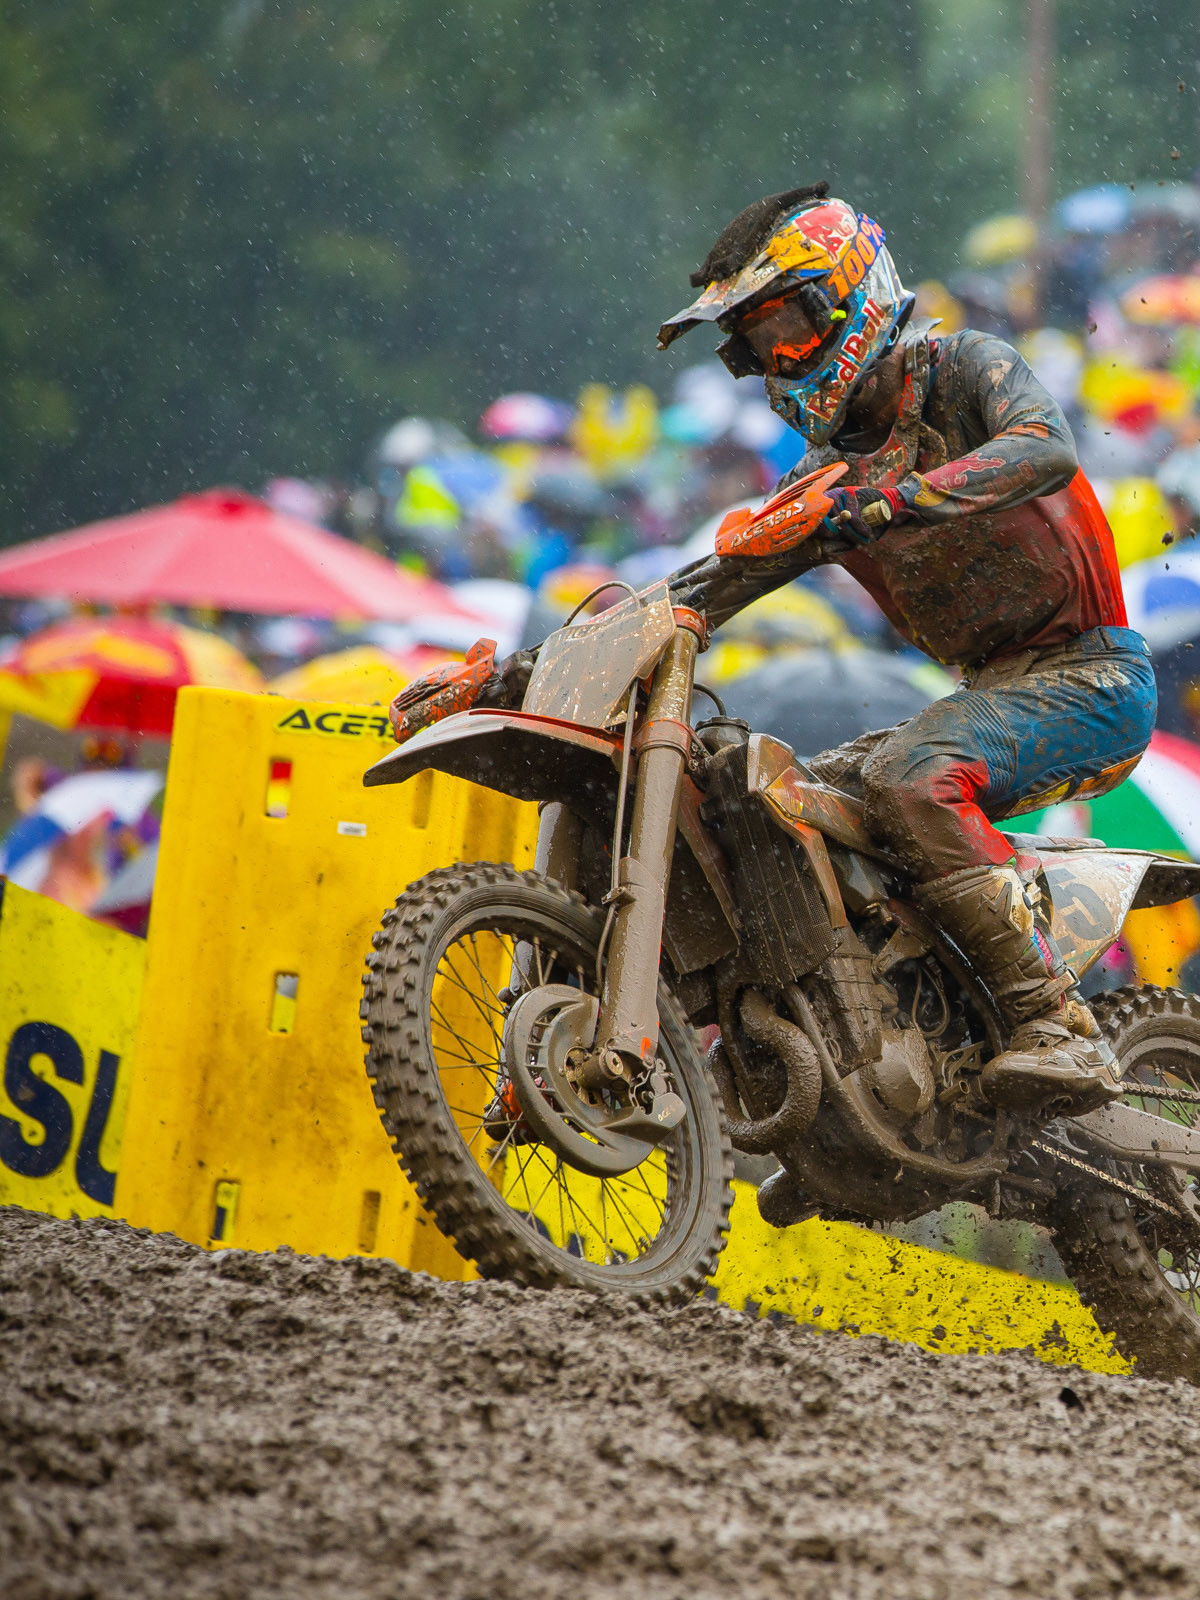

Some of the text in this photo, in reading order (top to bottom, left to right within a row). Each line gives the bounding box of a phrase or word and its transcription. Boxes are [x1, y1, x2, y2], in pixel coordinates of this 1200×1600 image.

[827, 213, 885, 300] 100%
[841, 298, 887, 365] Bull
[278, 709, 394, 738] ACER
